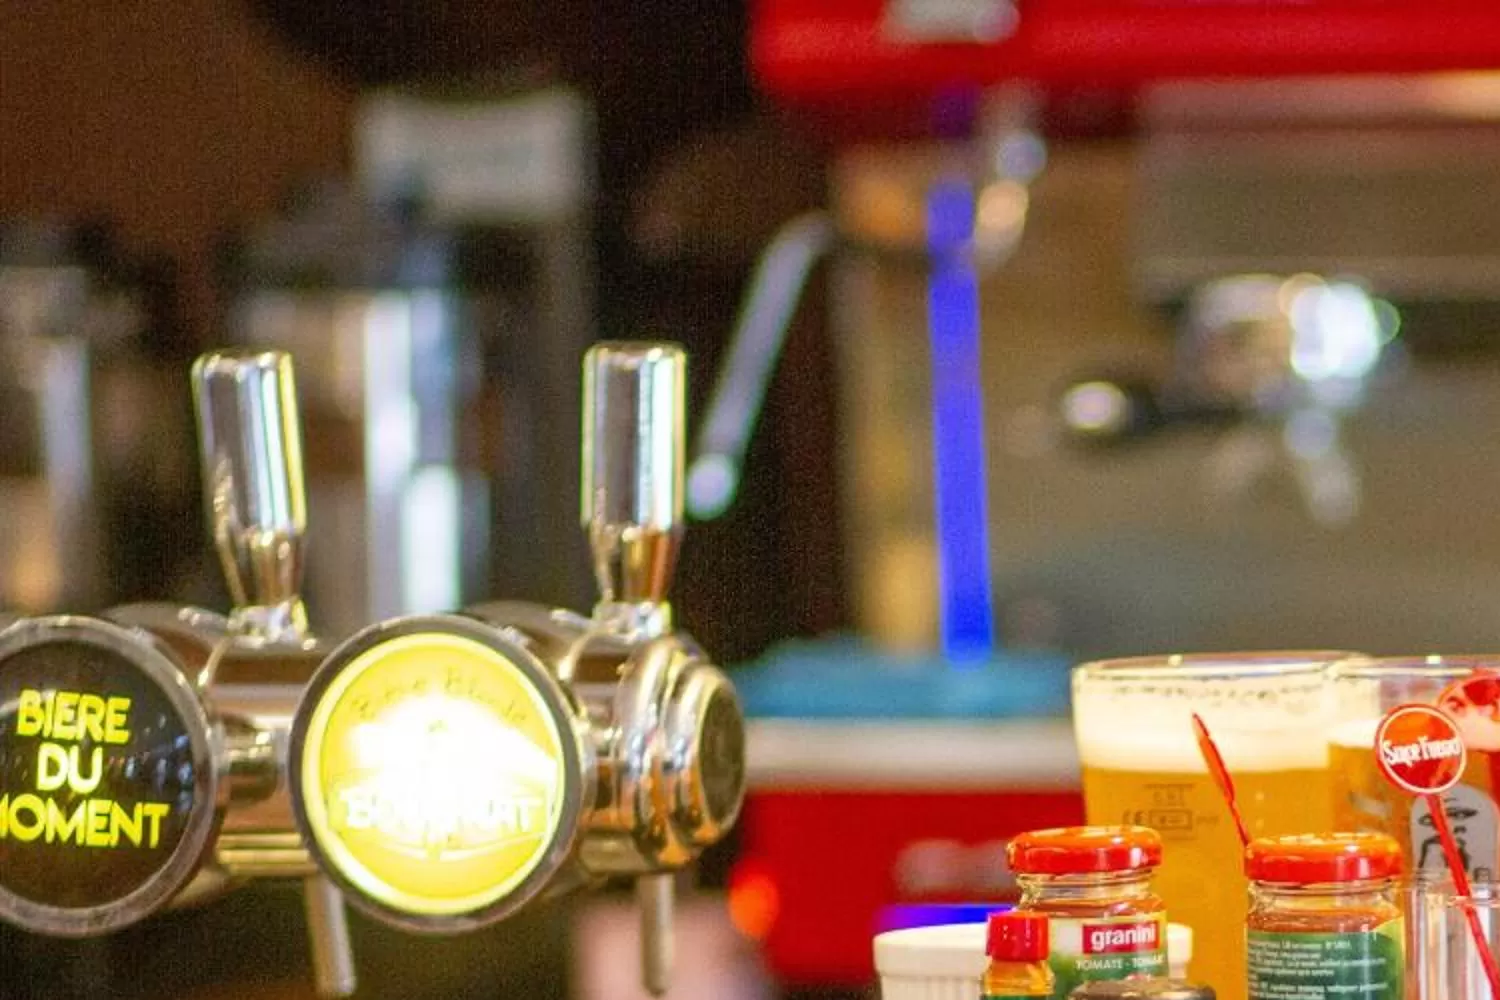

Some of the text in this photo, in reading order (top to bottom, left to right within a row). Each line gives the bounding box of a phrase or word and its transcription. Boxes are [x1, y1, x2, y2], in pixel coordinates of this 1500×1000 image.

[16, 688, 131, 744] BIERE
[37, 742, 103, 794] DU
[0, 792, 170, 849] OMENT
[1076, 957, 1123, 970] TOMATE
[1091, 923, 1156, 952] granini
